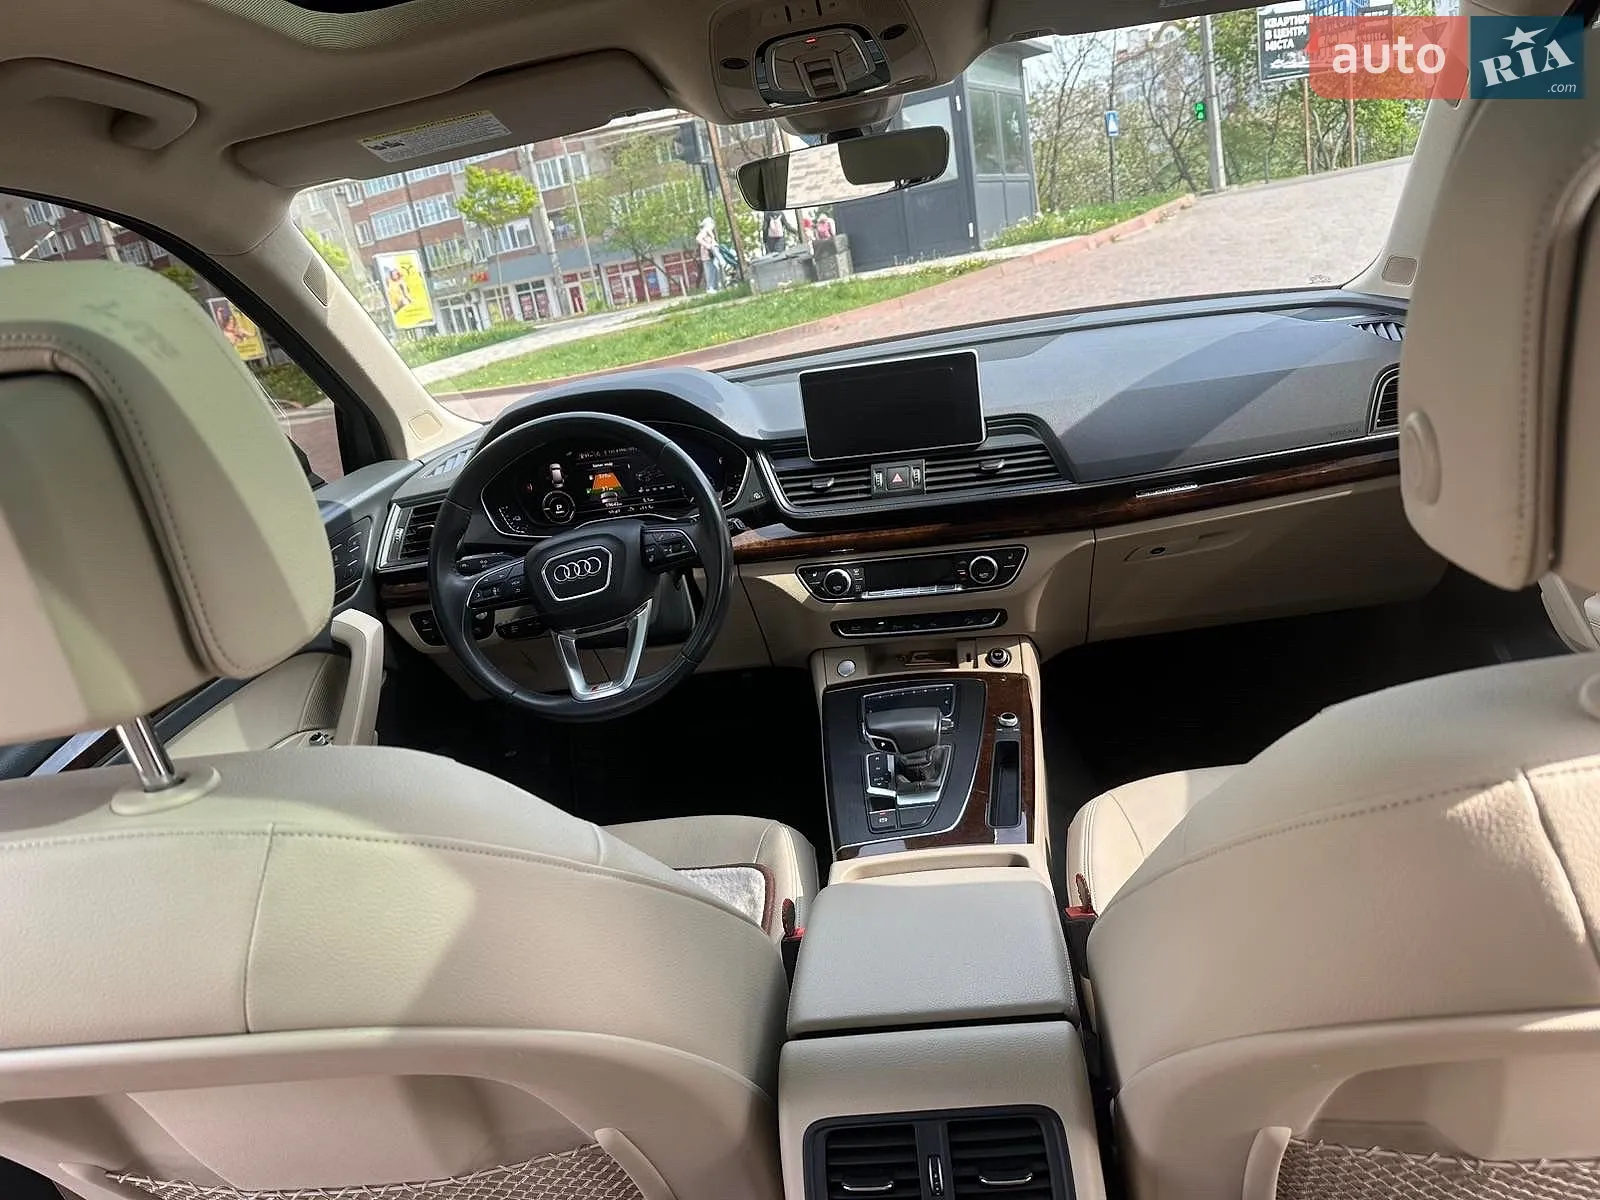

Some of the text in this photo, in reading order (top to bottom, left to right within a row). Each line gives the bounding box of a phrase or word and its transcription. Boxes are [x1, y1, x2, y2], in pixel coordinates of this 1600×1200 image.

[1264, 26, 1307, 41] В ЦЕНТРІ
[1265, 38, 1295, 51] МІСТА
